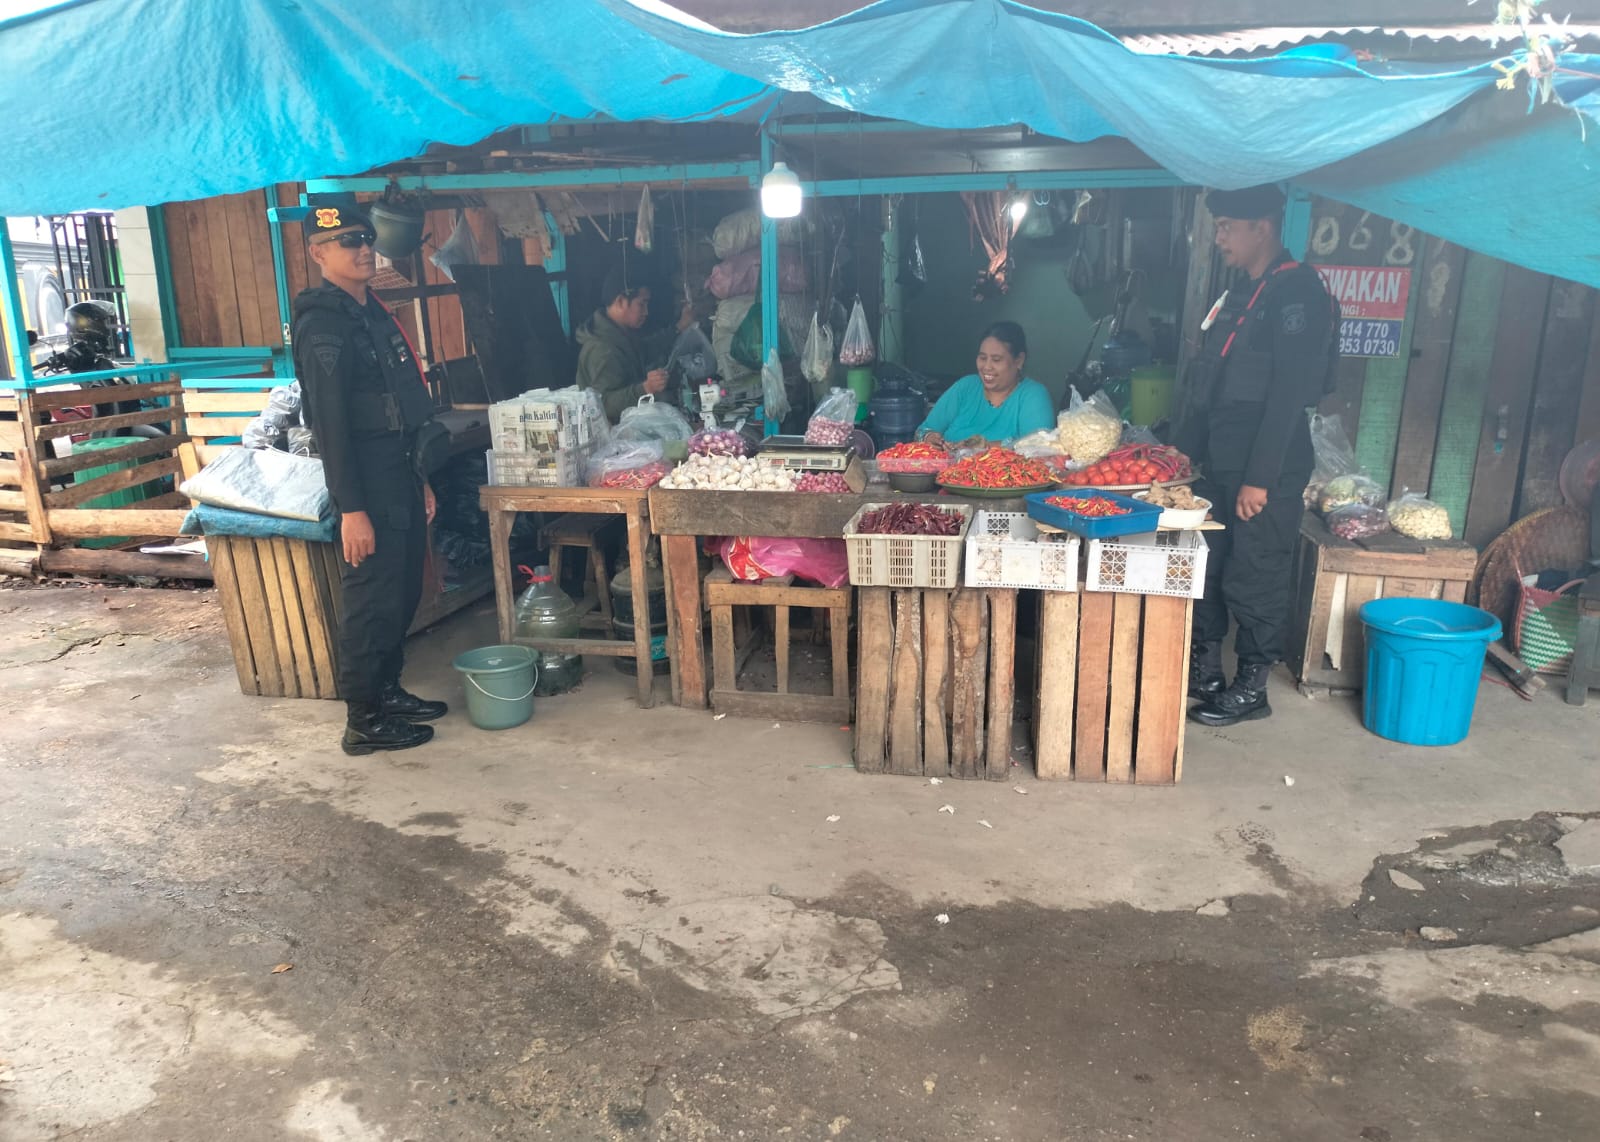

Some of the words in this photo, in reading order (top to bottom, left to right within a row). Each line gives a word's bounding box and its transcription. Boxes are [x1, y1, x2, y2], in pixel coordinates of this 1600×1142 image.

[1340, 304, 1360, 316] NGI
[1340, 320, 1363, 337] 414
[1366, 322, 1389, 338] 770
[1363, 339, 1395, 355] 0730
